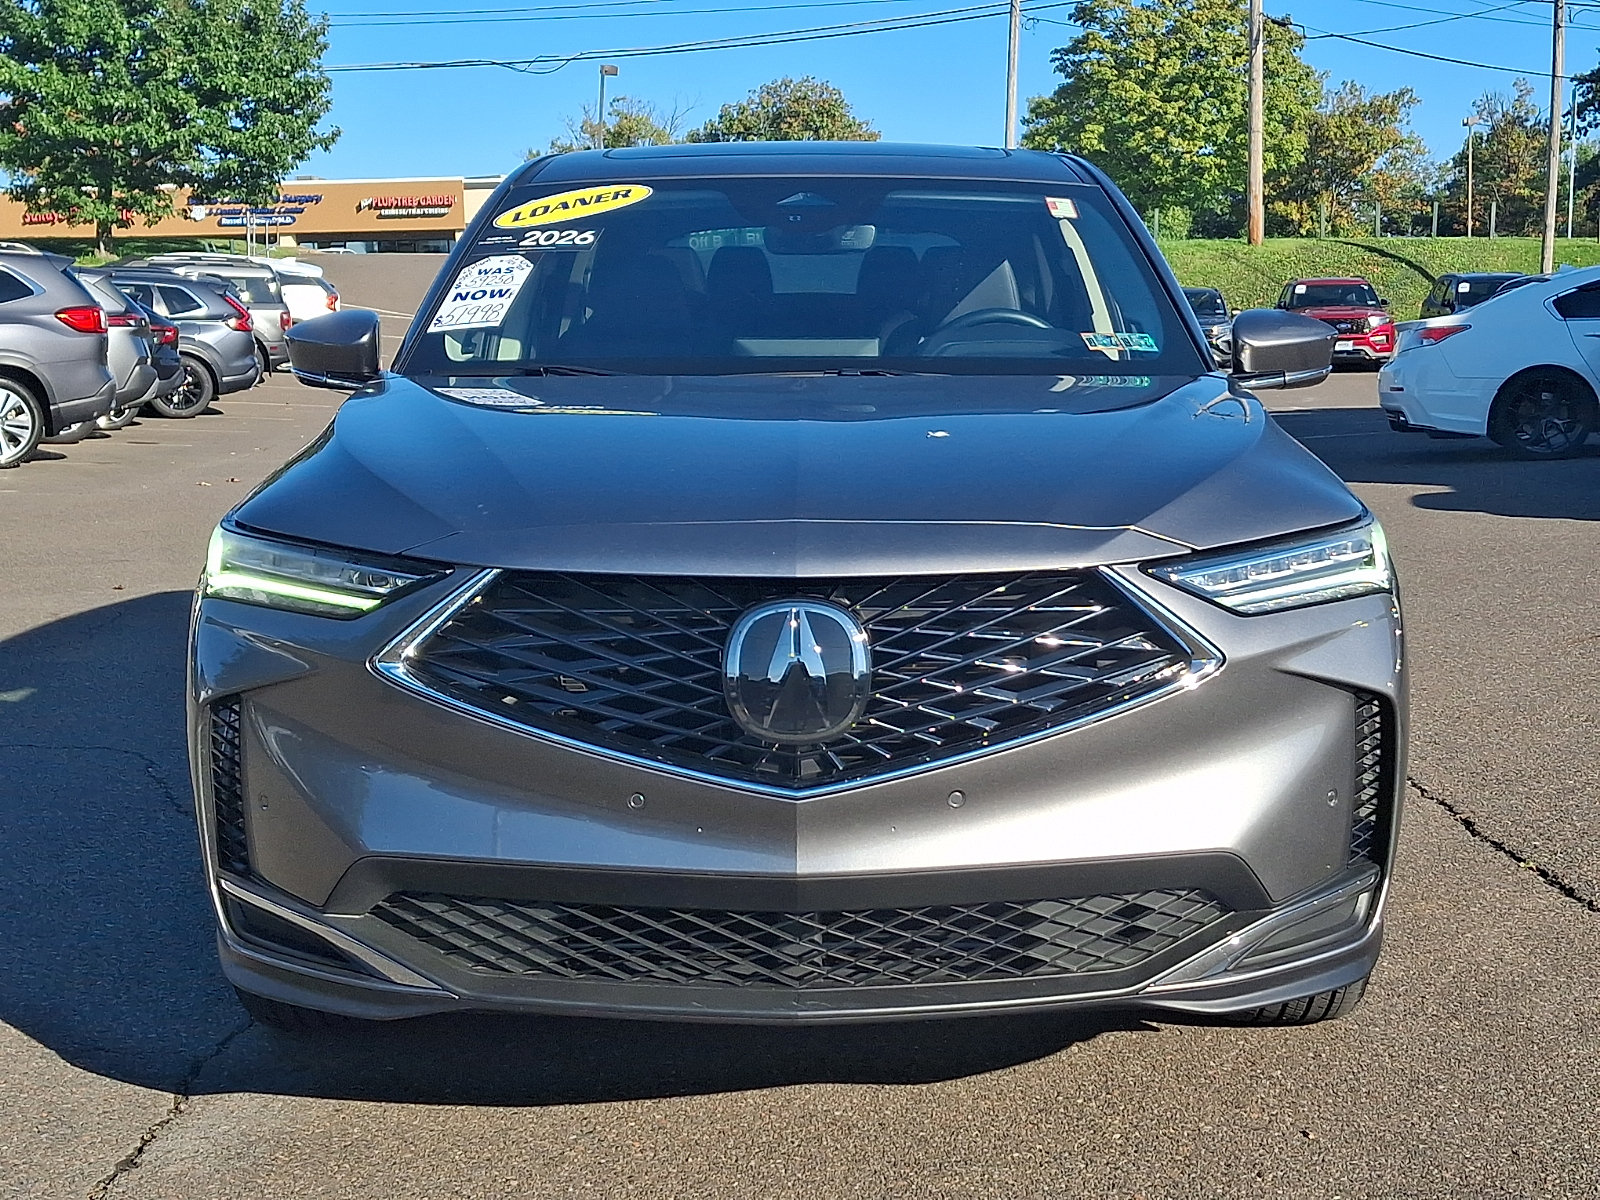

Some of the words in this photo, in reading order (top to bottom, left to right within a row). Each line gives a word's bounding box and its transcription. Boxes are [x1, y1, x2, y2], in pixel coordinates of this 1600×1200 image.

[420, 195, 455, 206] GARDEN
[511, 188, 632, 223] LOANER
[518, 230, 596, 247] 2026
[477, 267, 515, 276] WAS
[451, 288, 511, 302] NOW
